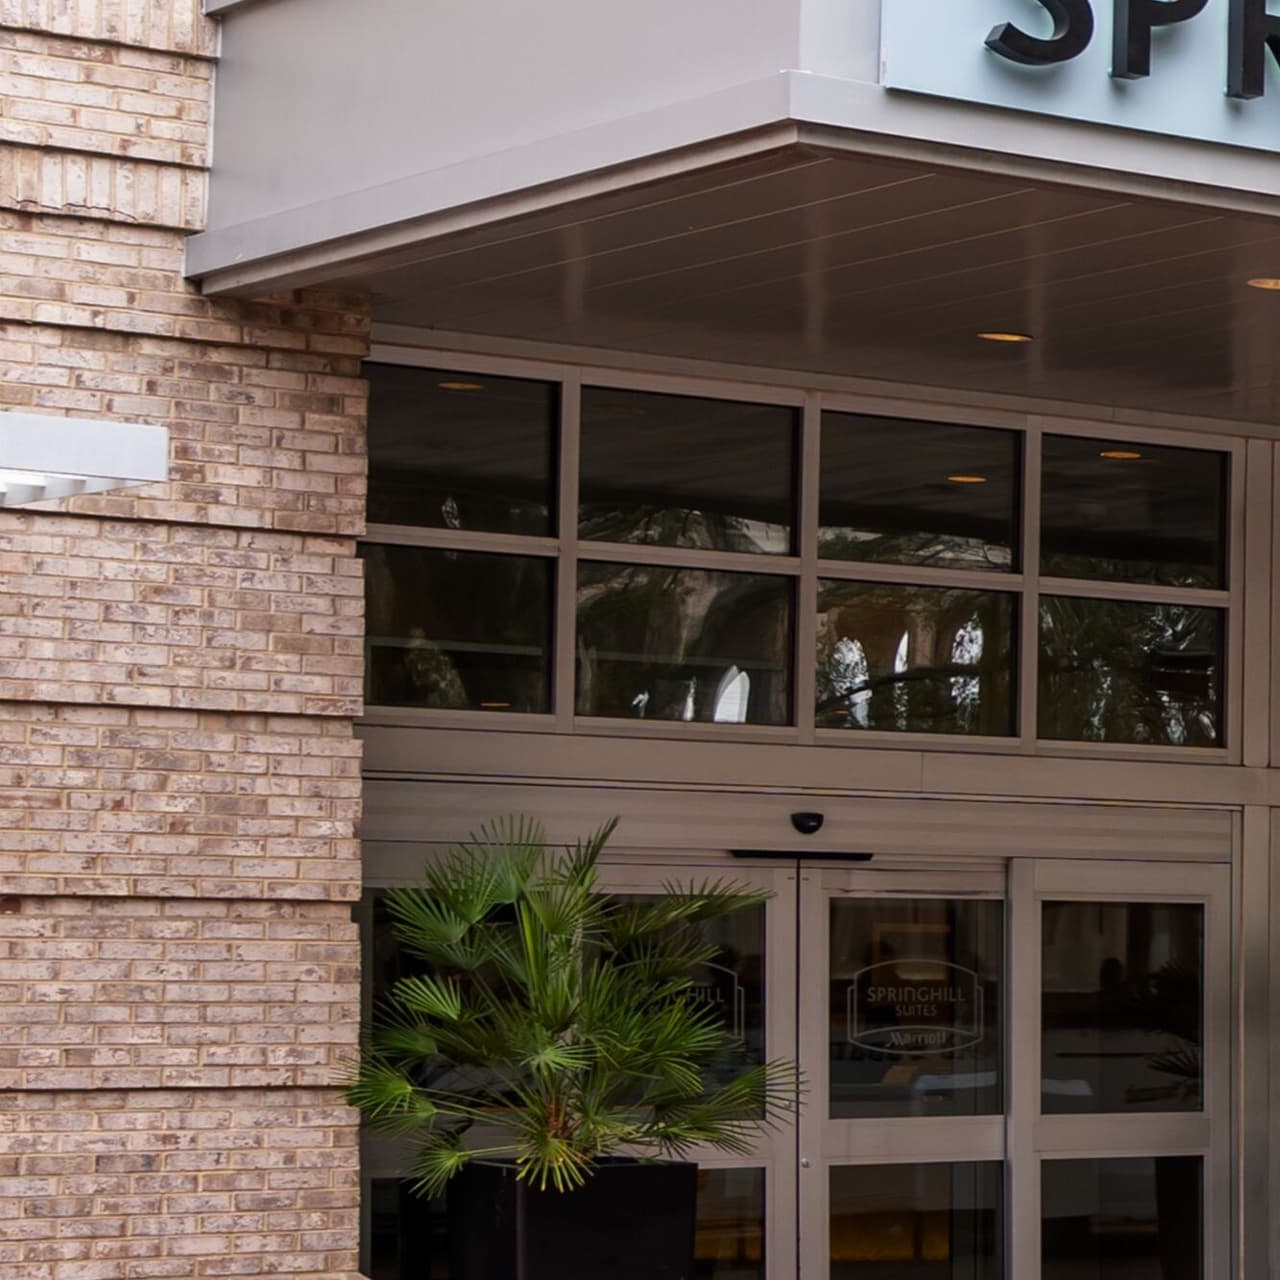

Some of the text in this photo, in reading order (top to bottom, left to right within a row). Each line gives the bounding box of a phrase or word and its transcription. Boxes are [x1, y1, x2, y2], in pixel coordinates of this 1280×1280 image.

[867, 987, 966, 1002] SPRINGHILL
[896, 1004, 937, 1017] SUITES
[885, 1031, 947, 1047] Marriott
